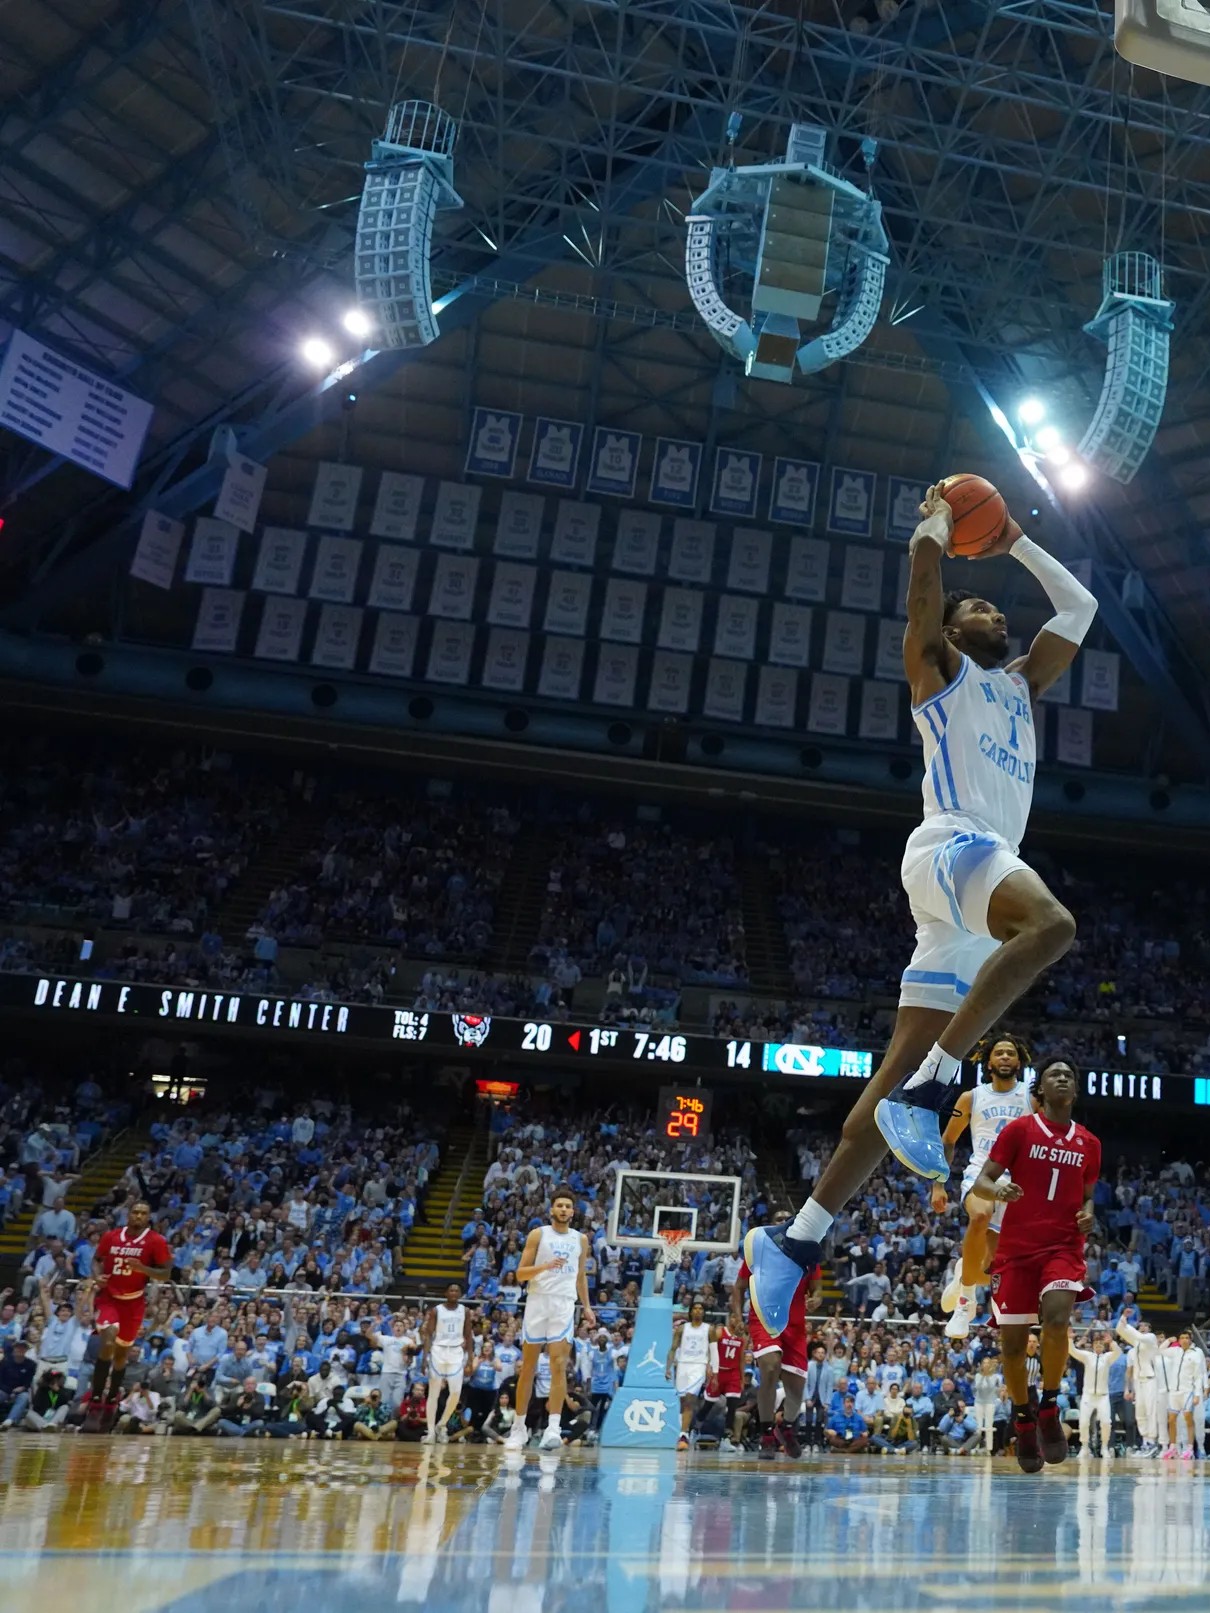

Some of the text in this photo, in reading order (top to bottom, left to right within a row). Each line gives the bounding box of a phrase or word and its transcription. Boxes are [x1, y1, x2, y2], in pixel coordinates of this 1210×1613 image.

[1008, 715, 1019, 751] 1
[34, 979, 102, 1011] DEAN
[159, 990, 241, 1023] SMITH
[256, 999, 349, 1032] CENTER
[394, 1010, 429, 1027] TOL: 4
[392, 1025, 427, 1041] FLS: 7
[521, 1022, 552, 1051] 20
[589, 1029, 618, 1054] 1ST
[633, 1033, 687, 1062] 7:46
[726, 1041, 751, 1068] 14
[840, 1050, 873, 1065] TOL: 4
[840, 1065, 872, 1078] FLS: 3
[1087, 1071, 1162, 1100] CENTER
[676, 1096, 703, 1113] 7:46
[982, 1105, 1024, 1121] NORTH
[667, 1112, 698, 1137] 29
[1029, 1144, 1085, 1168] NC STATE
[1047, 1167, 1060, 1201] 1
[110, 1246, 143, 1256] NC STATE
[1051, 1280, 1070, 1289] PACK
[690, 1341, 697, 1349] 2
[725, 1346, 737, 1359] 14
